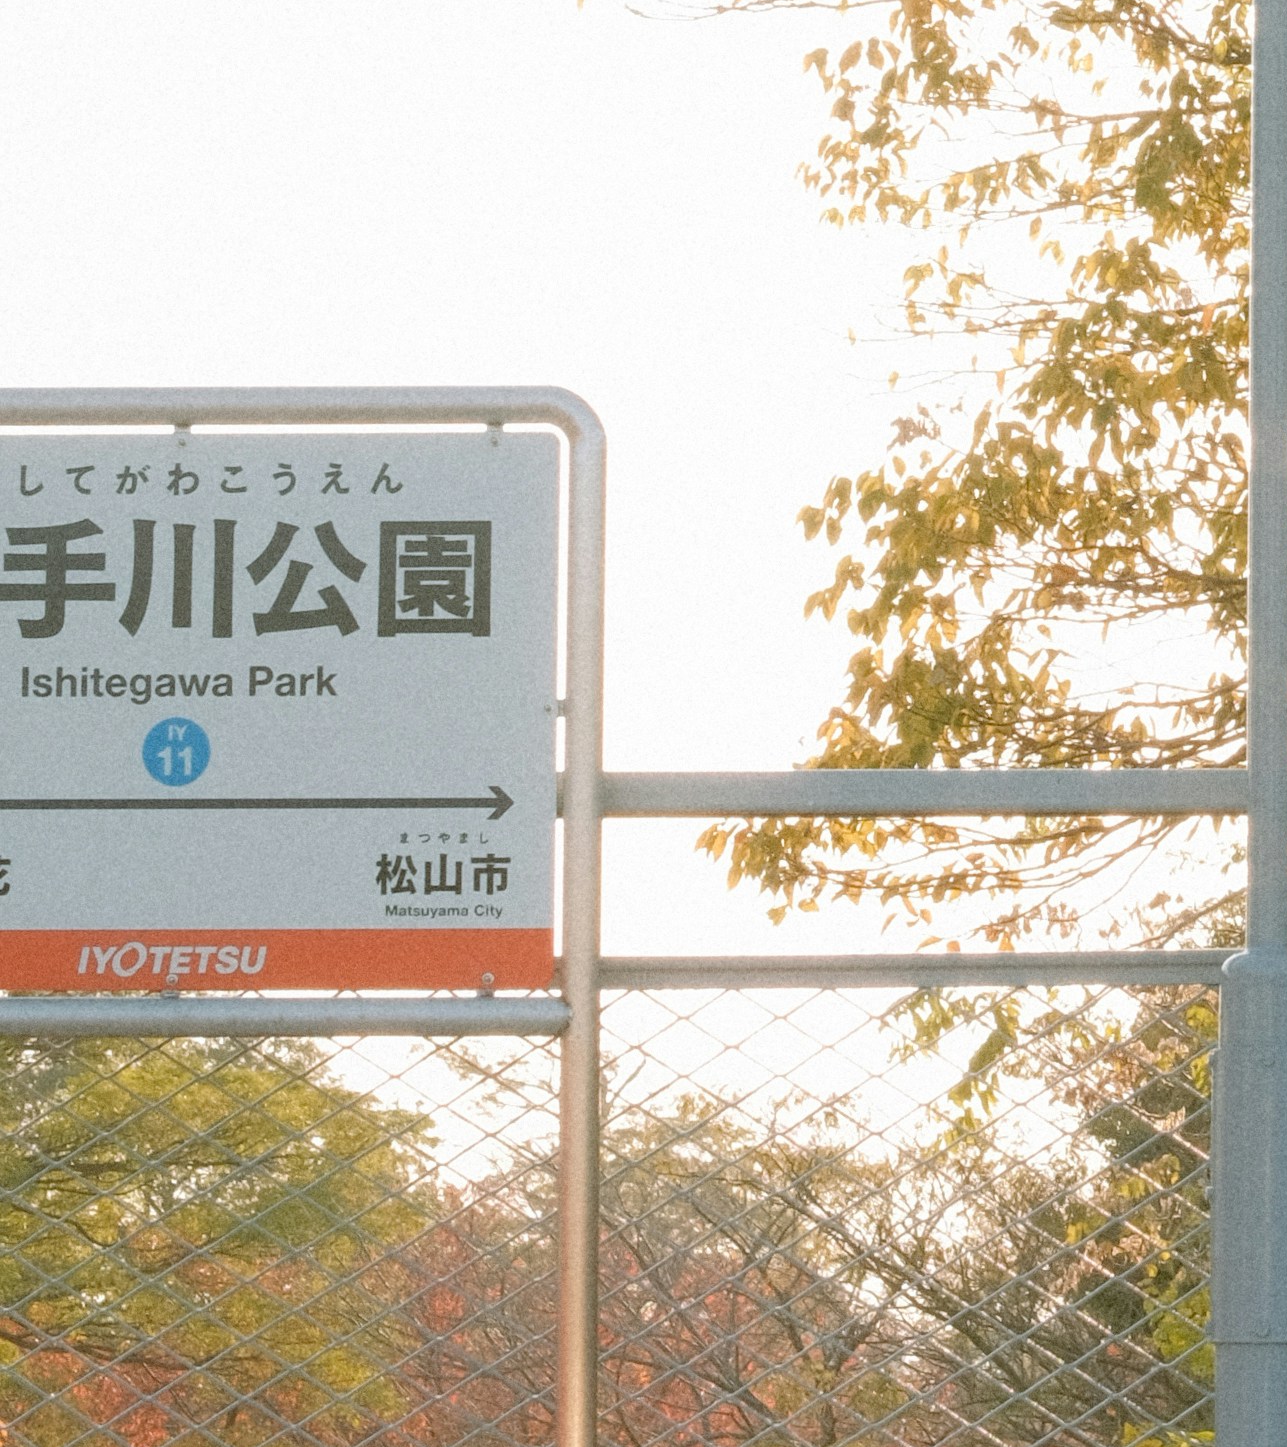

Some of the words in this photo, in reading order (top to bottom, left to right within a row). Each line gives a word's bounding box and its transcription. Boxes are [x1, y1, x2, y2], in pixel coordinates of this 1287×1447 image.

[20, 462, 404, 496] してがわこうえん
[0, 517, 493, 639] 手川公園
[20, 665, 233, 704] Ishitegawa
[249, 665, 338, 698] Park
[168, 724, 189, 740] IY
[157, 747, 194, 777] 11
[400, 832, 489, 844] まつやまし
[376, 853, 512, 895] 松山市
[385, 904, 469, 919] Matsuyama
[473, 904, 503, 919] City
[77, 940, 267, 978] IYOTETSU
